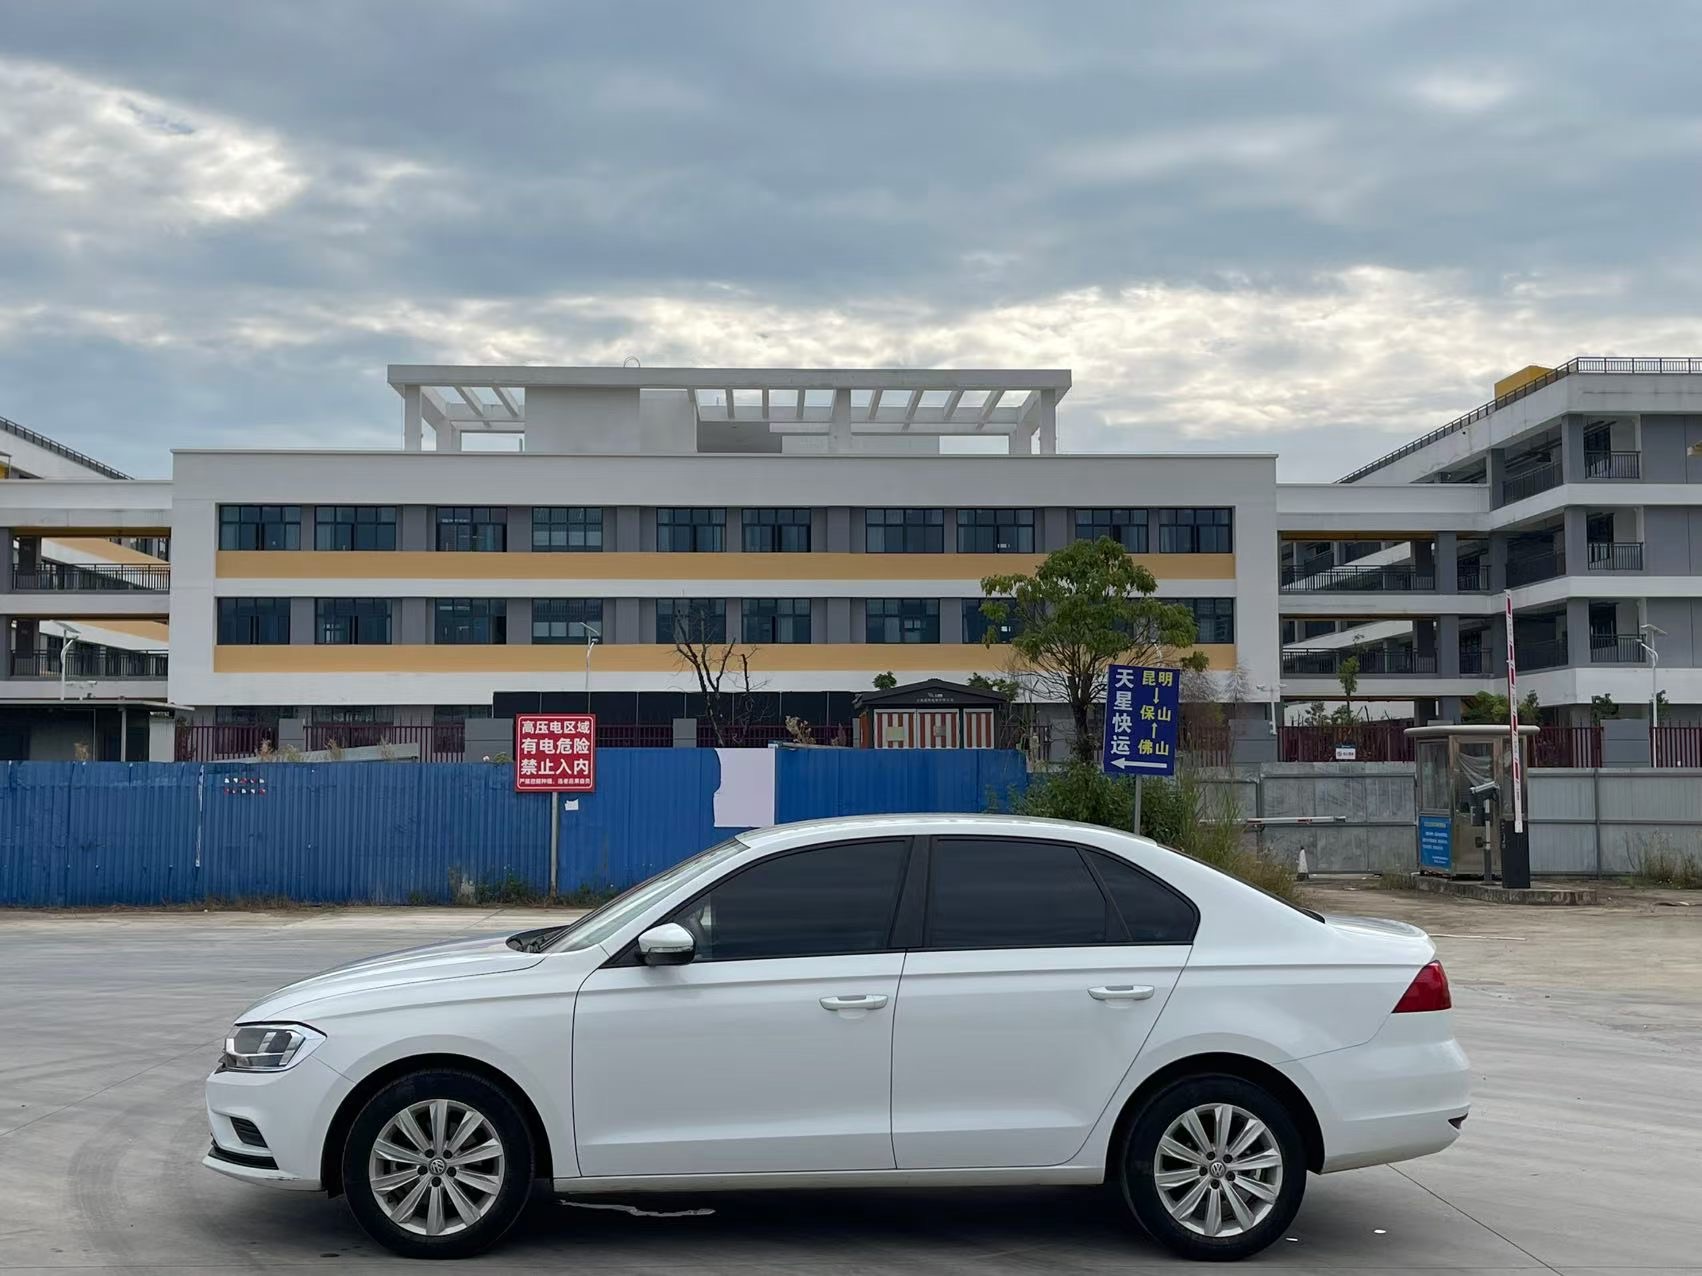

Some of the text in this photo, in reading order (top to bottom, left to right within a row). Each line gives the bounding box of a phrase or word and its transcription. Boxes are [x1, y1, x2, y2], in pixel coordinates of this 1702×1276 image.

[1142, 670, 1173, 686] 昆明
[1111, 669, 1134, 755] 天星快运
[1140, 705, 1171, 721] 保山
[521, 721, 590, 734] 高压电区域
[521, 738, 590, 754] 有电危险
[1138, 739, 1169, 755] 佛山
[521, 758, 589, 775] 禁止入内
